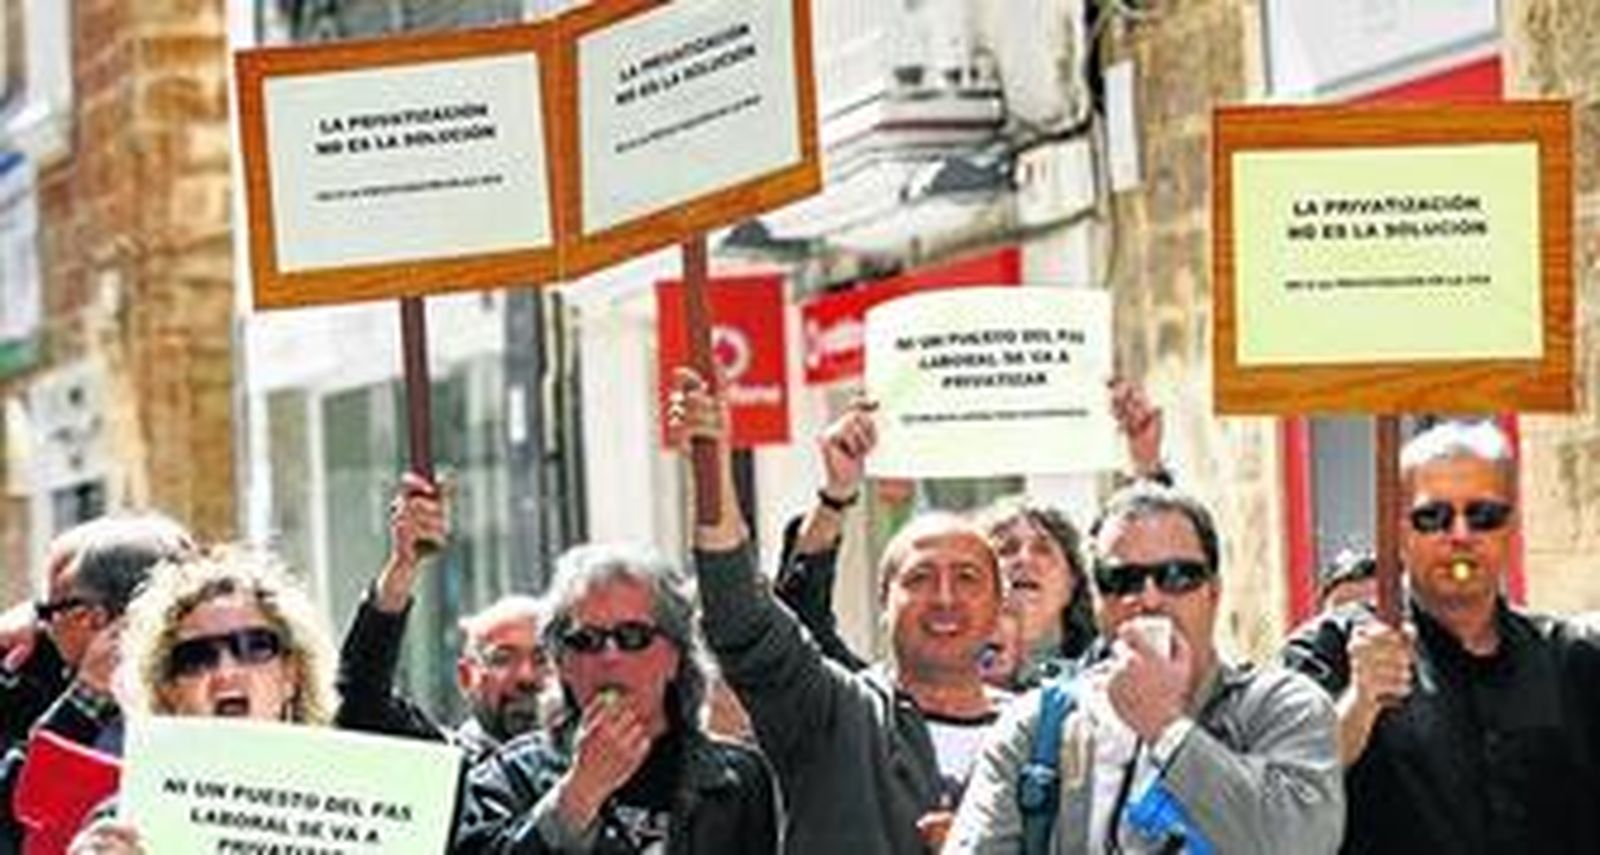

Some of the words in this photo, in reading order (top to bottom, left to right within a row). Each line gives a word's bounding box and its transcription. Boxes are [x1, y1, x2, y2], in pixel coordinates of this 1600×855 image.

[320, 118, 343, 134] LA
[314, 140, 343, 154] NO
[348, 137, 370, 152] ES
[376, 134, 398, 150] LA
[404, 123, 496, 147] SOLUCIÓN
[1293, 200, 1318, 216] LA
[1324, 195, 1480, 215] PRIVATIZACIÓN
[1288, 224, 1317, 240] NO
[1323, 224, 1347, 239] ES
[1352, 223, 1378, 239] LA
[1384, 219, 1487, 238] SOLUCIÓN
[949, 330, 1017, 346] PUESTO
[1022, 329, 1052, 344] DEL
[919, 353, 997, 369] LABORAL
[1058, 349, 1070, 364] A
[942, 371, 1047, 388] PRIVATIZAR
[163, 778, 187, 793] NI
[194, 781, 226, 799] UN
[233, 786, 320, 810] PUESTO
[325, 797, 362, 817] DEL
[371, 802, 412, 821] PAS
[190, 808, 289, 834] LABORAL
[298, 821, 324, 837] SE
[330, 827, 358, 842] VA
[365, 830, 379, 843] A
